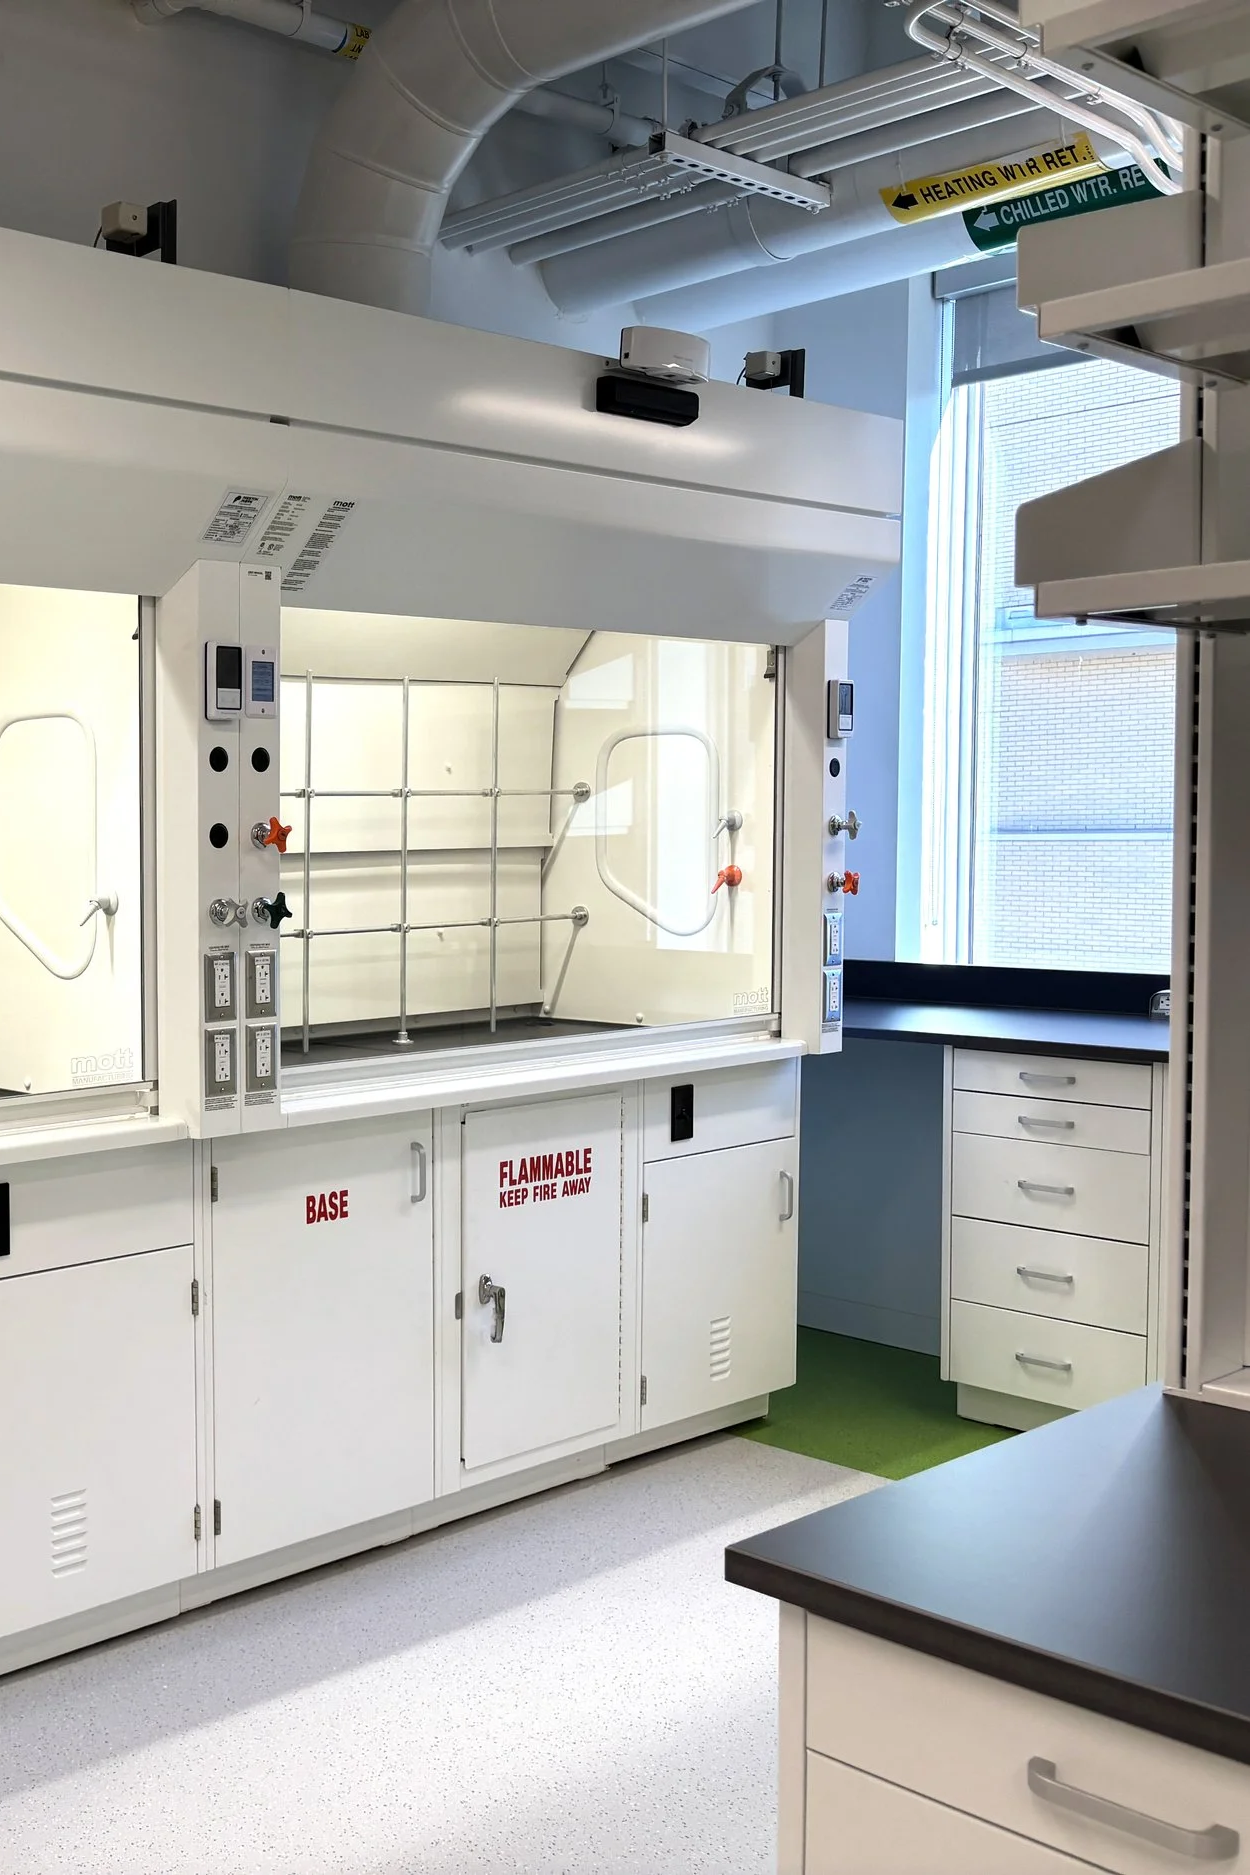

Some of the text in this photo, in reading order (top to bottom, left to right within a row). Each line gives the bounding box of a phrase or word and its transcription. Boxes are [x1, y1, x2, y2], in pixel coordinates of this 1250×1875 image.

[919, 169, 997, 205] HEATING
[1044, 144, 1088, 171] RET.
[999, 164, 1147, 226] CHILLED WTR. RE
[332, 499, 356, 508] mott
[733, 987, 769, 1006] mott
[70, 1047, 134, 1075] mott
[499, 1147, 593, 1188] FLAMMABLE
[305, 1189, 349, 1225] BASE
[499, 1176, 592, 1209] KEEP FIRE AWAY
